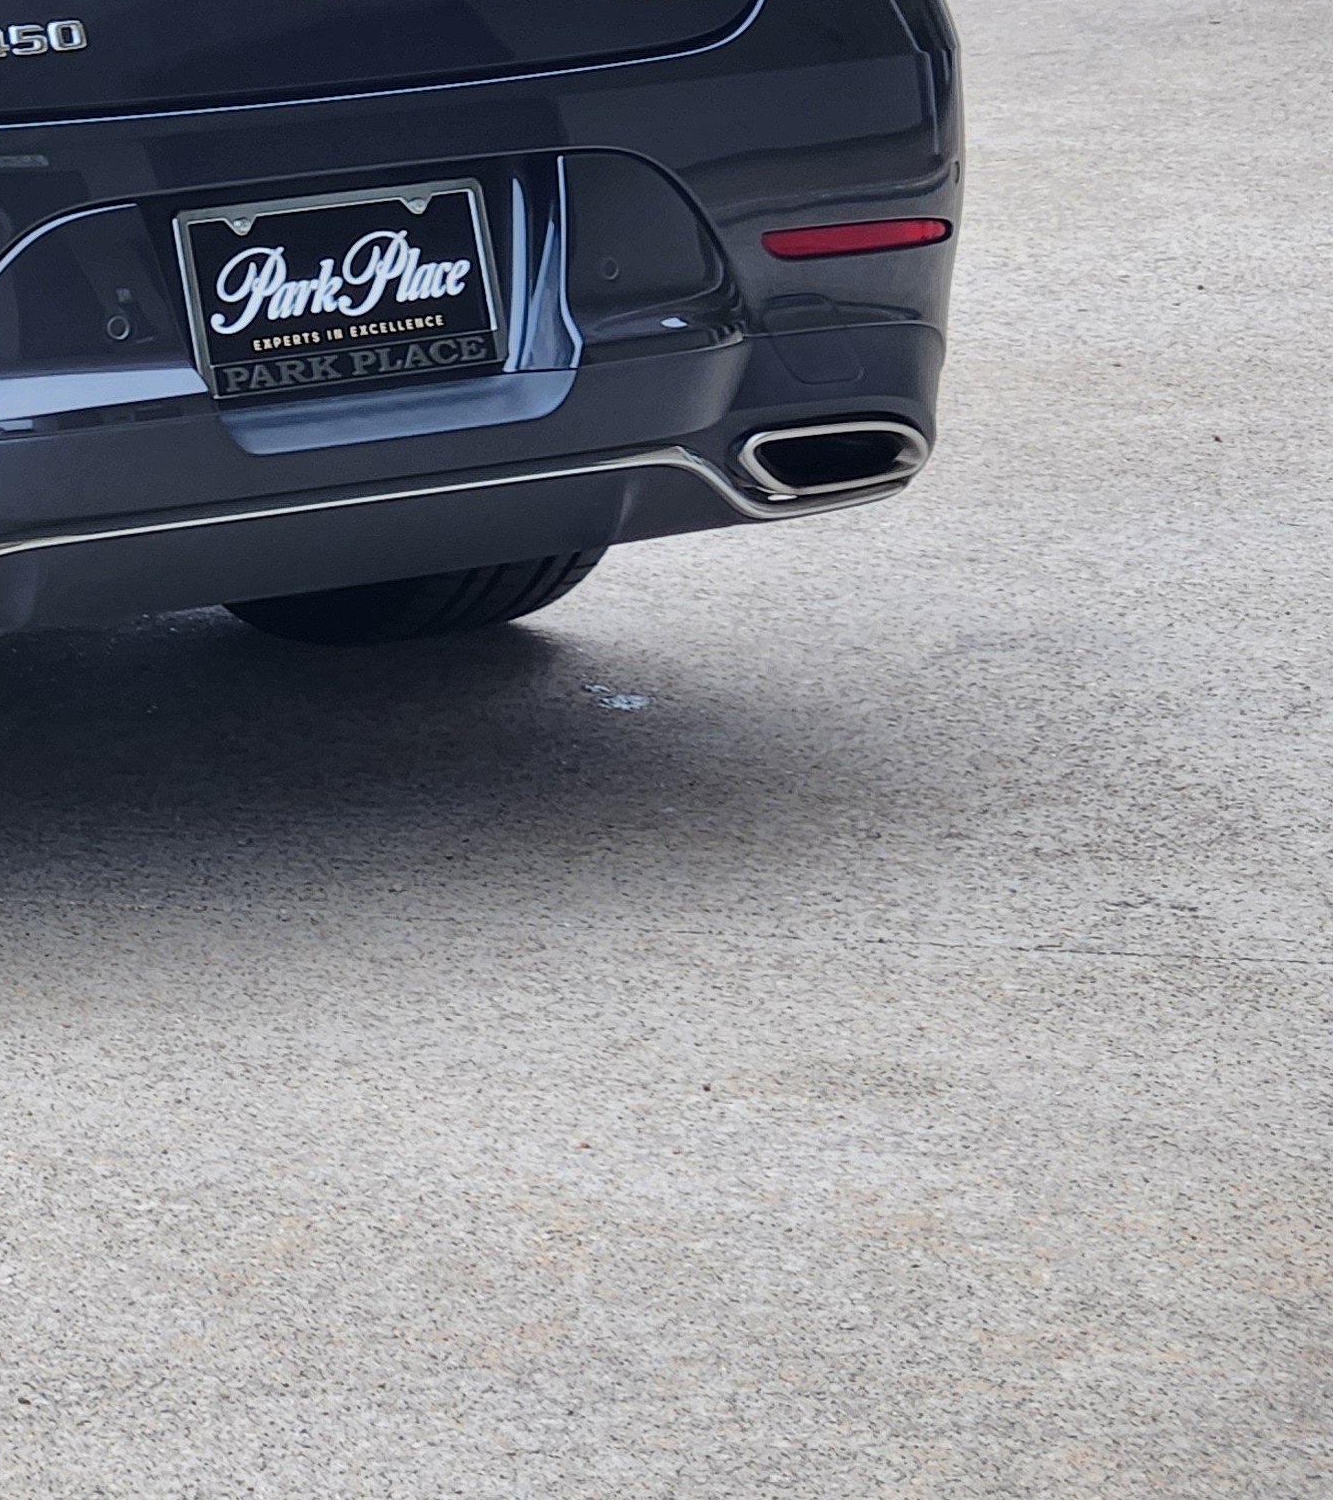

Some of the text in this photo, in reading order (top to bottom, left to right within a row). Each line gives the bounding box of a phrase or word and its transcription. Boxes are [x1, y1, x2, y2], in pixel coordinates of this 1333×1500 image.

[210, 229, 471, 335] Park Place
[252, 314, 445, 352] EXPERTS IN EXCELLENCE
[222, 335, 487, 393] PARK PLACE
